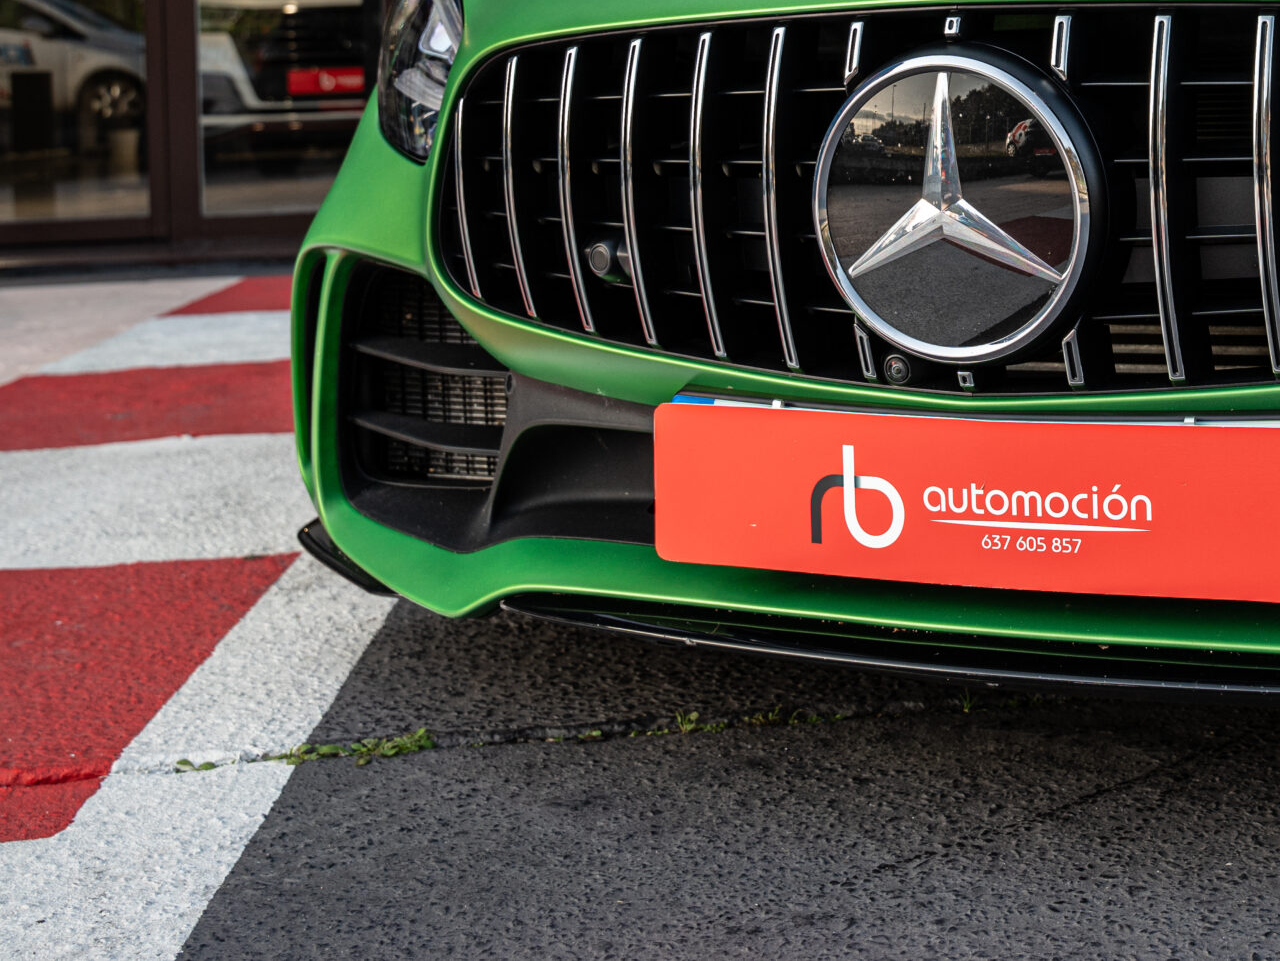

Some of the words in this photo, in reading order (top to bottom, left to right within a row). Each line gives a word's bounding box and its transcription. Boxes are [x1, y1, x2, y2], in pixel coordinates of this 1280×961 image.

[810, 444, 905, 549] rb
[922, 482, 1153, 522] automoción
[981, 534, 1011, 551] 637
[1016, 536, 1047, 552] 605
[1051, 538, 1082, 554] 857
